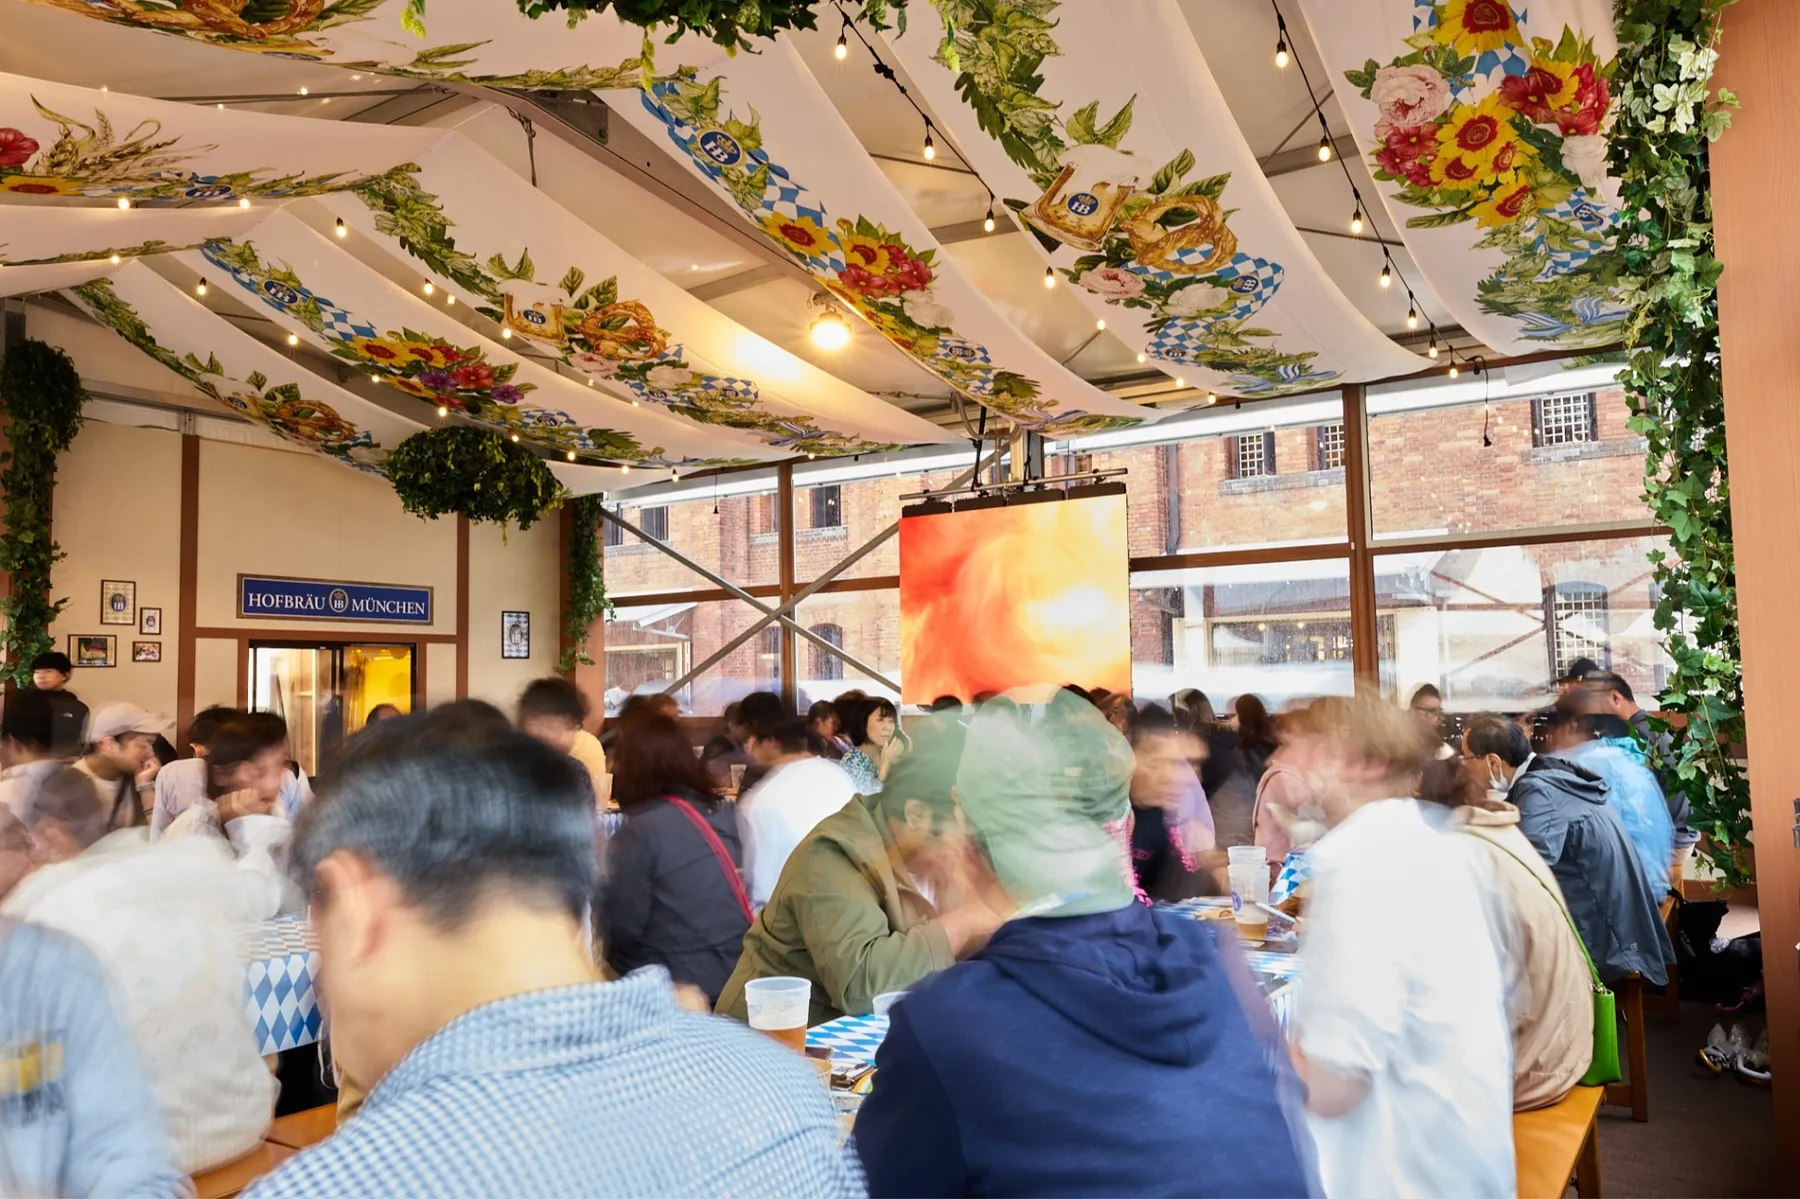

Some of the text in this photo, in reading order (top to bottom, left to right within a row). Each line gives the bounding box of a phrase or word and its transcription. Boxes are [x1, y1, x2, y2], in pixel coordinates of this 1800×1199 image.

[702, 140, 729, 163] HB
[1070, 201, 1091, 215] HB
[249, 592, 426, 615] HOFBRÄU HB MÜNCHEN
